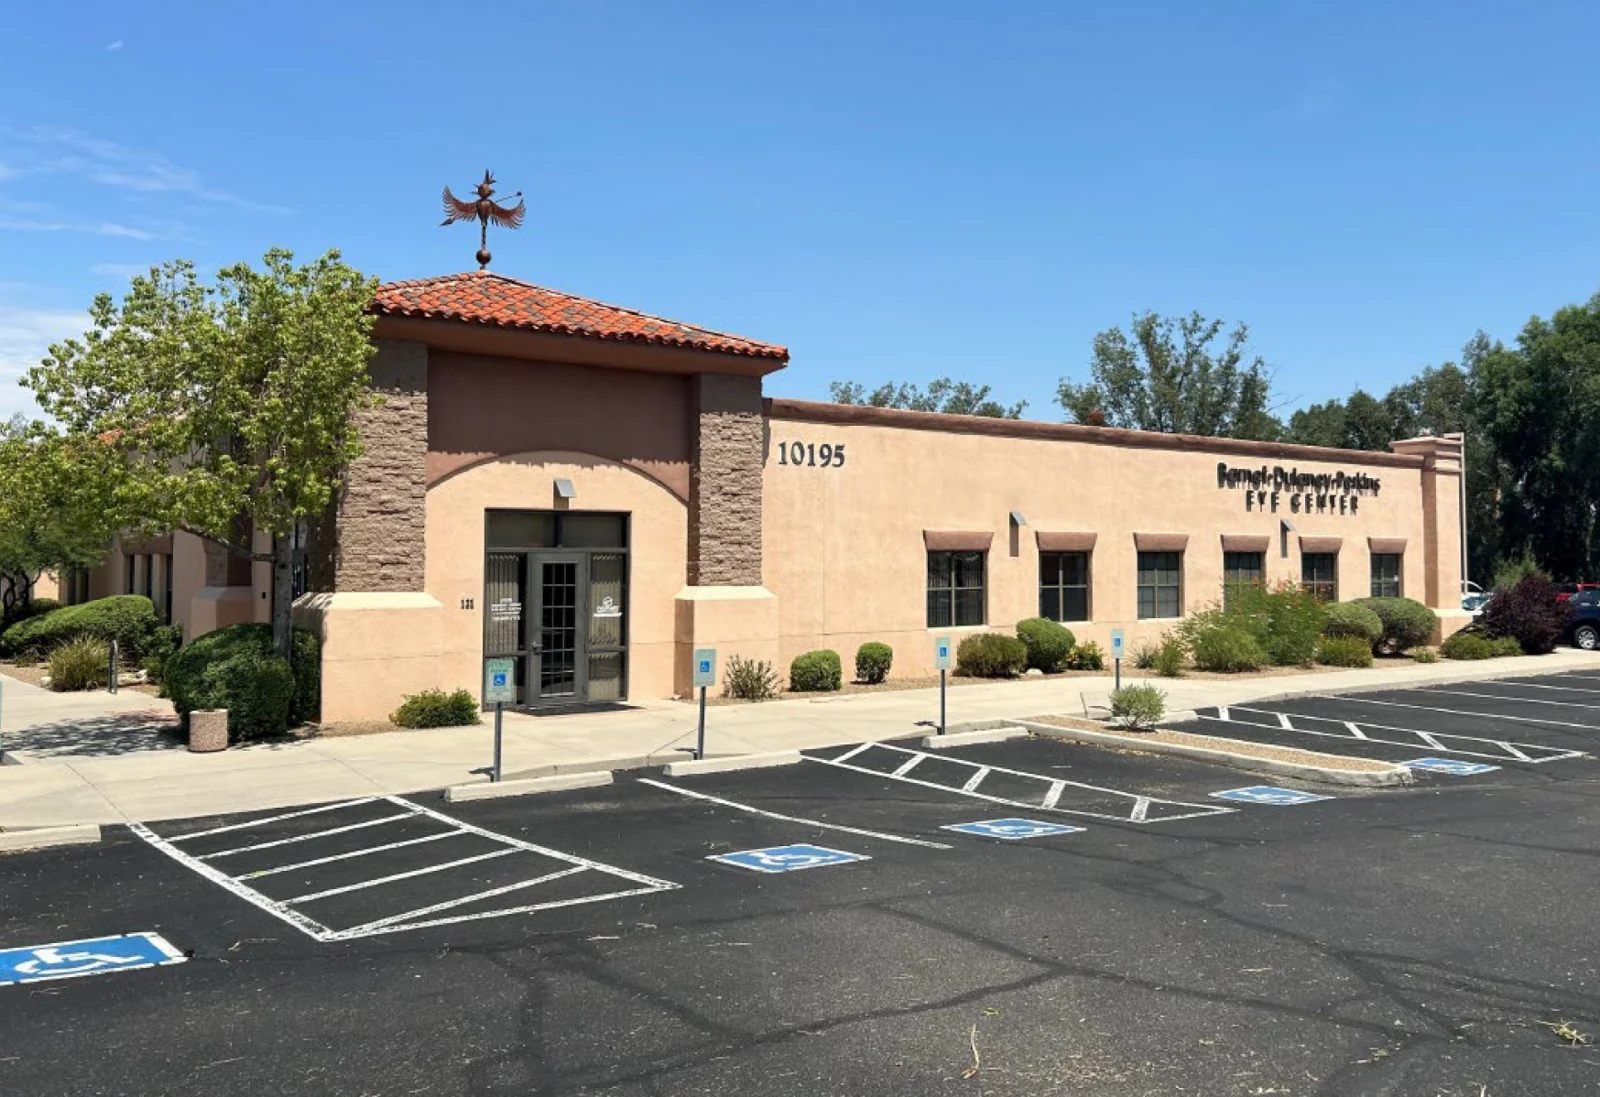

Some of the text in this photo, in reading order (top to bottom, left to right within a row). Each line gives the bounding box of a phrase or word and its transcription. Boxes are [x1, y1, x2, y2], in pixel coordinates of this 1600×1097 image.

[778, 441, 845, 468] 10195
[1246, 490, 1358, 513] EYE CENTER
